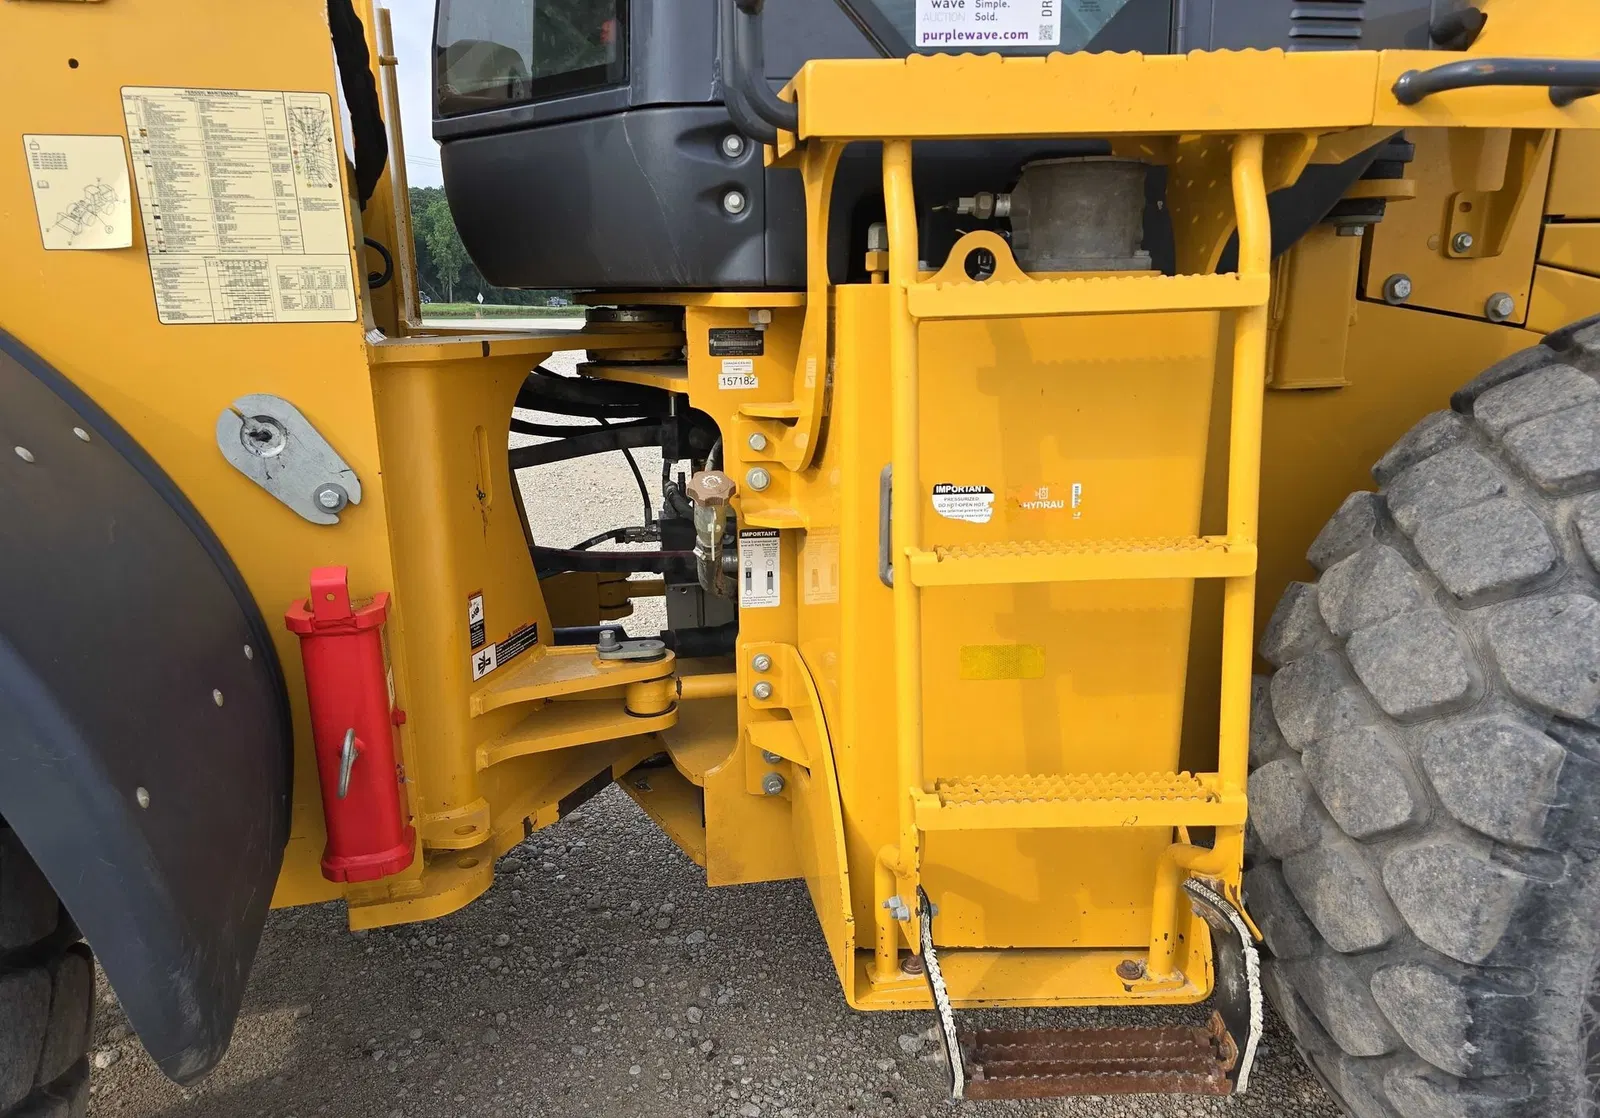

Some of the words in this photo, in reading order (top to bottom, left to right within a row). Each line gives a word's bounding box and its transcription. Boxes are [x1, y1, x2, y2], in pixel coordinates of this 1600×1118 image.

[931, 0, 965, 8] wave
[975, 0, 1010, 9] Simple.
[923, 12, 965, 22] AUCTION
[975, 12, 998, 21] Sold.
[923, 29, 1029, 43] purplewave.com
[722, 376, 756, 386] 157182
